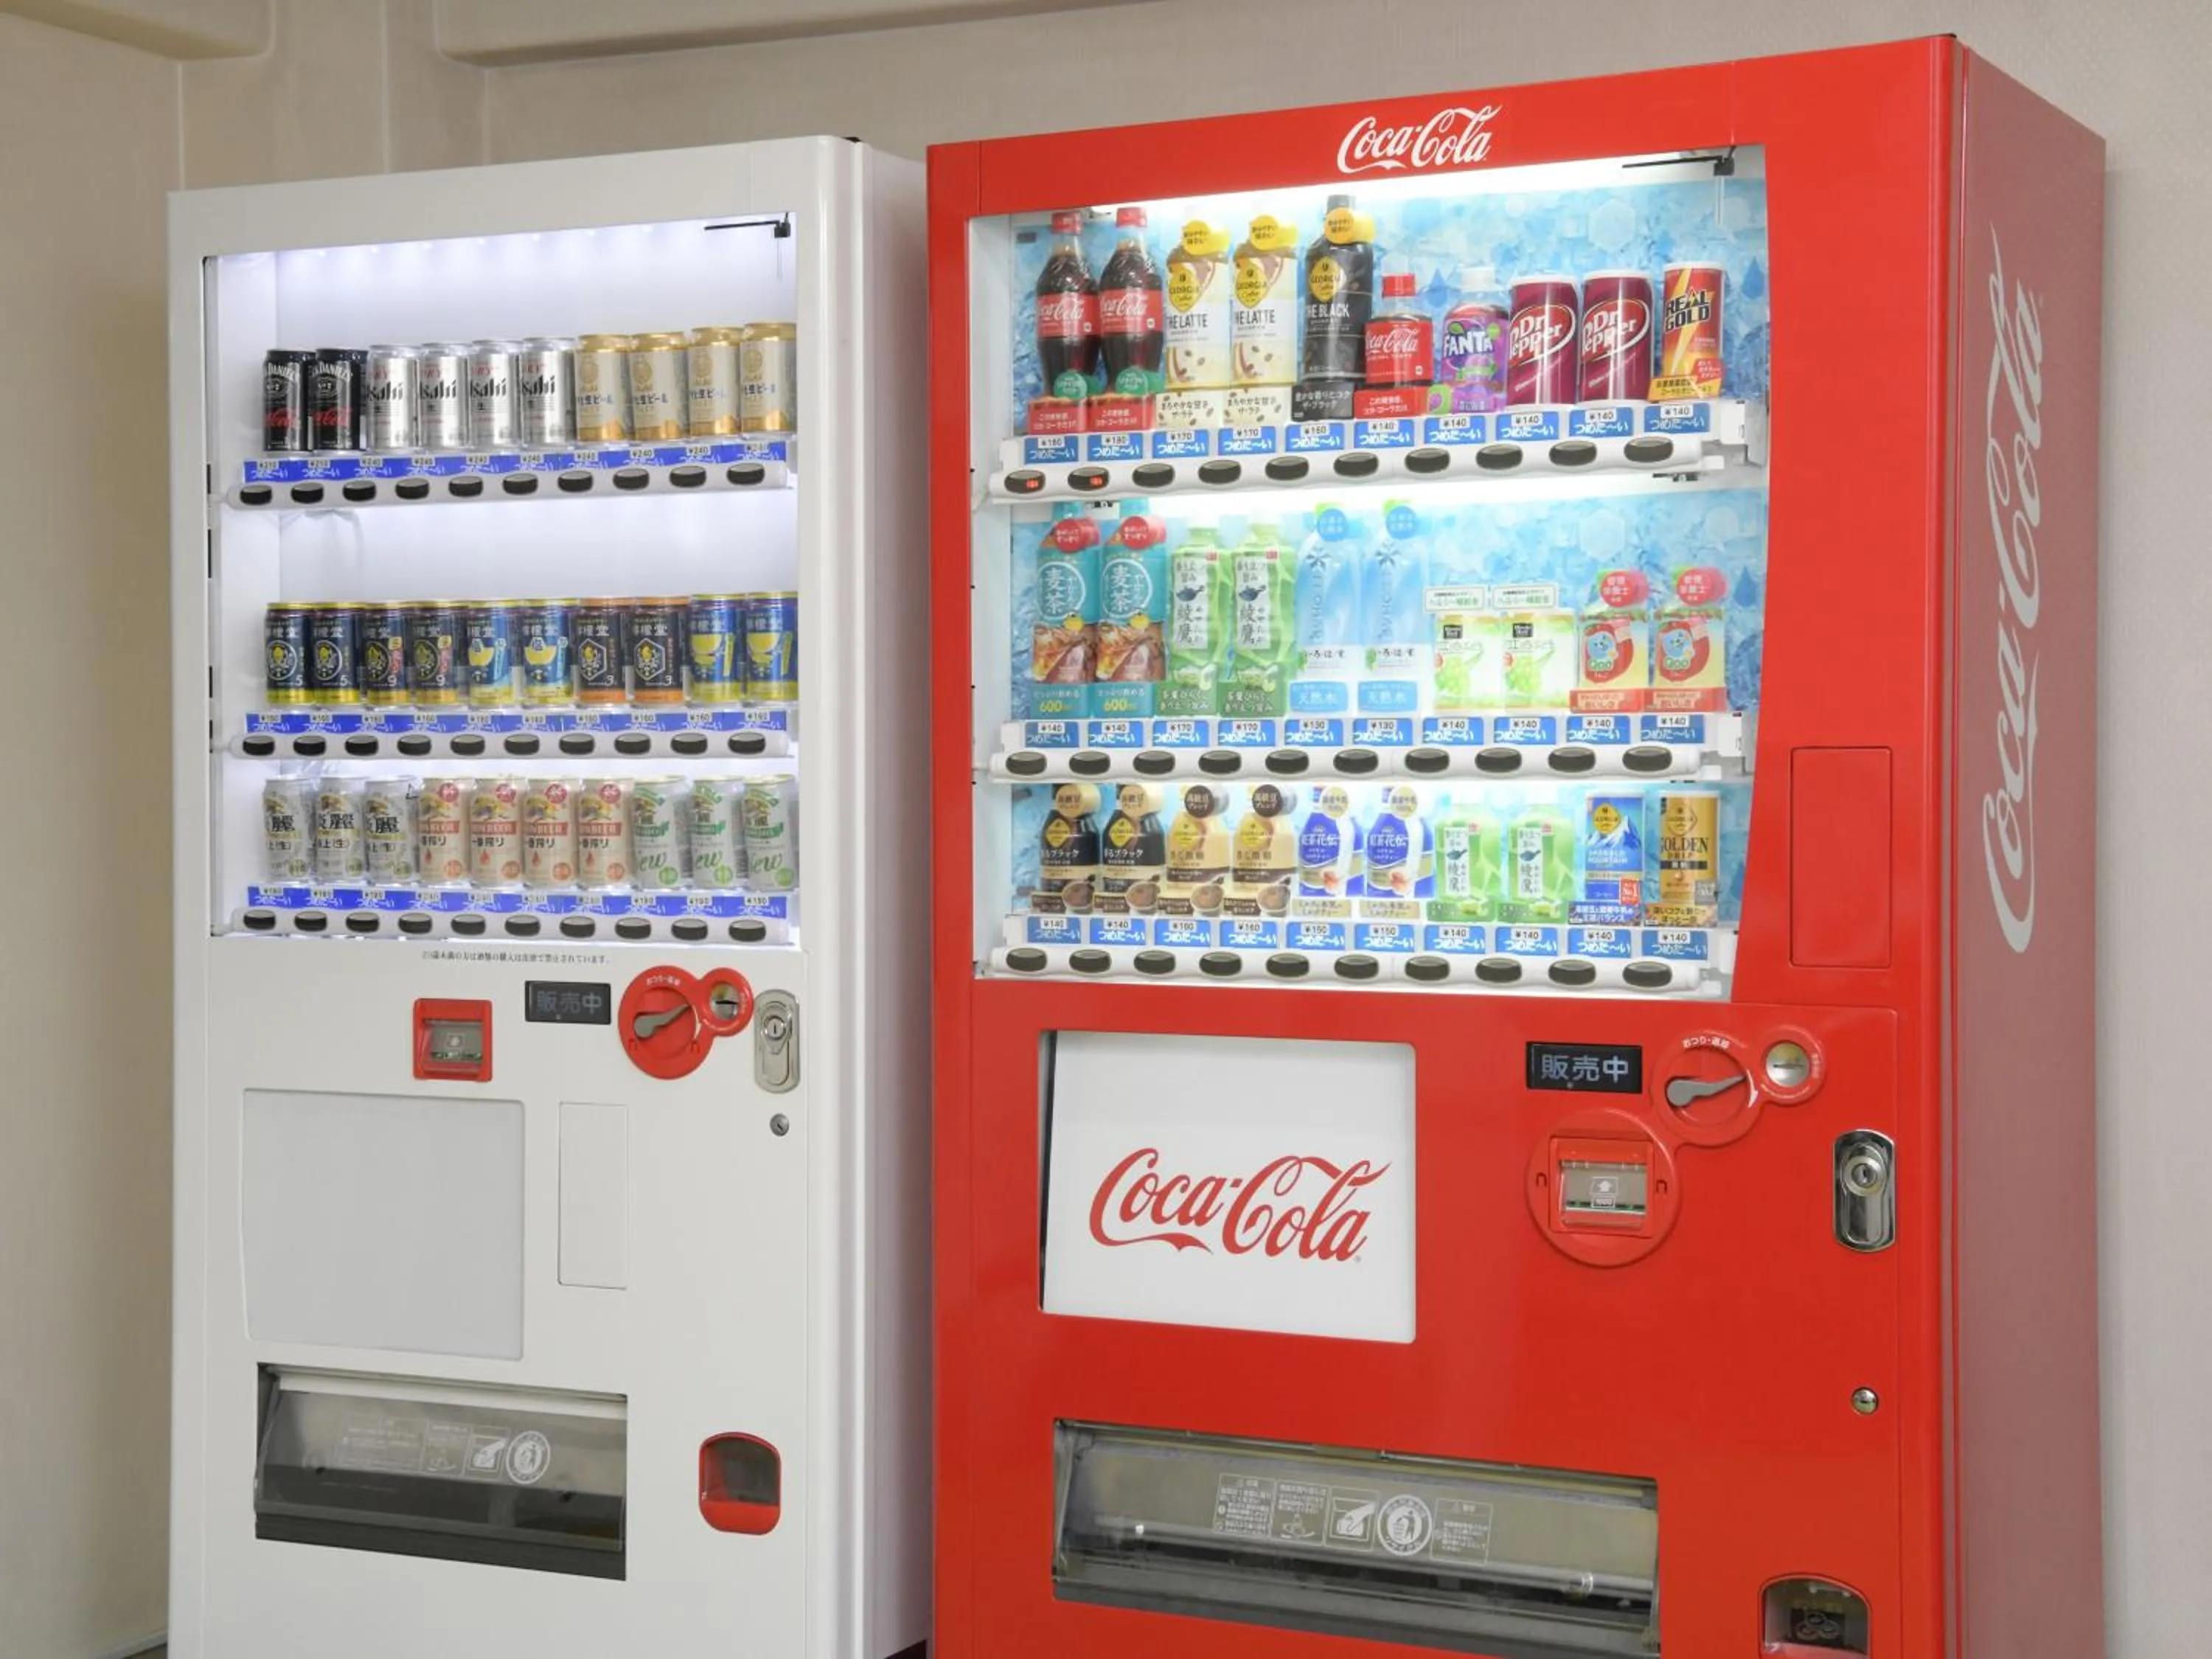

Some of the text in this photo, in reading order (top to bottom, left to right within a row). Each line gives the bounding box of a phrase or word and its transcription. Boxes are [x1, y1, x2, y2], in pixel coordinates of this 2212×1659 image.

[1337, 103, 1503, 174] Coca-Cola
[1319, 304, 1350, 318] BLACK
[1665, 289, 1711, 316] REAL
[1180, 314, 1208, 328] LATTE
[1246, 310, 1276, 324] LATTE
[1665, 305, 1711, 332] GOLD
[1444, 330, 1493, 358] FANTA
[1443, 419, 1467, 427] ¥140
[1515, 416, 1539, 424] ¥140
[1589, 411, 1614, 420] ¥140
[1665, 406, 1690, 415] ¥140
[1372, 422, 1394, 431] ¥140
[1045, 568, 1063, 614] 麦茶
[1110, 565, 1129, 612] 麦茶
[1981, 219, 2043, 954] Coca-Cola
[537, 990, 603, 1015] 販売中
[1540, 1054, 1630, 1083] 販売中
[1089, 1147, 1392, 1262] Coca-Cola
